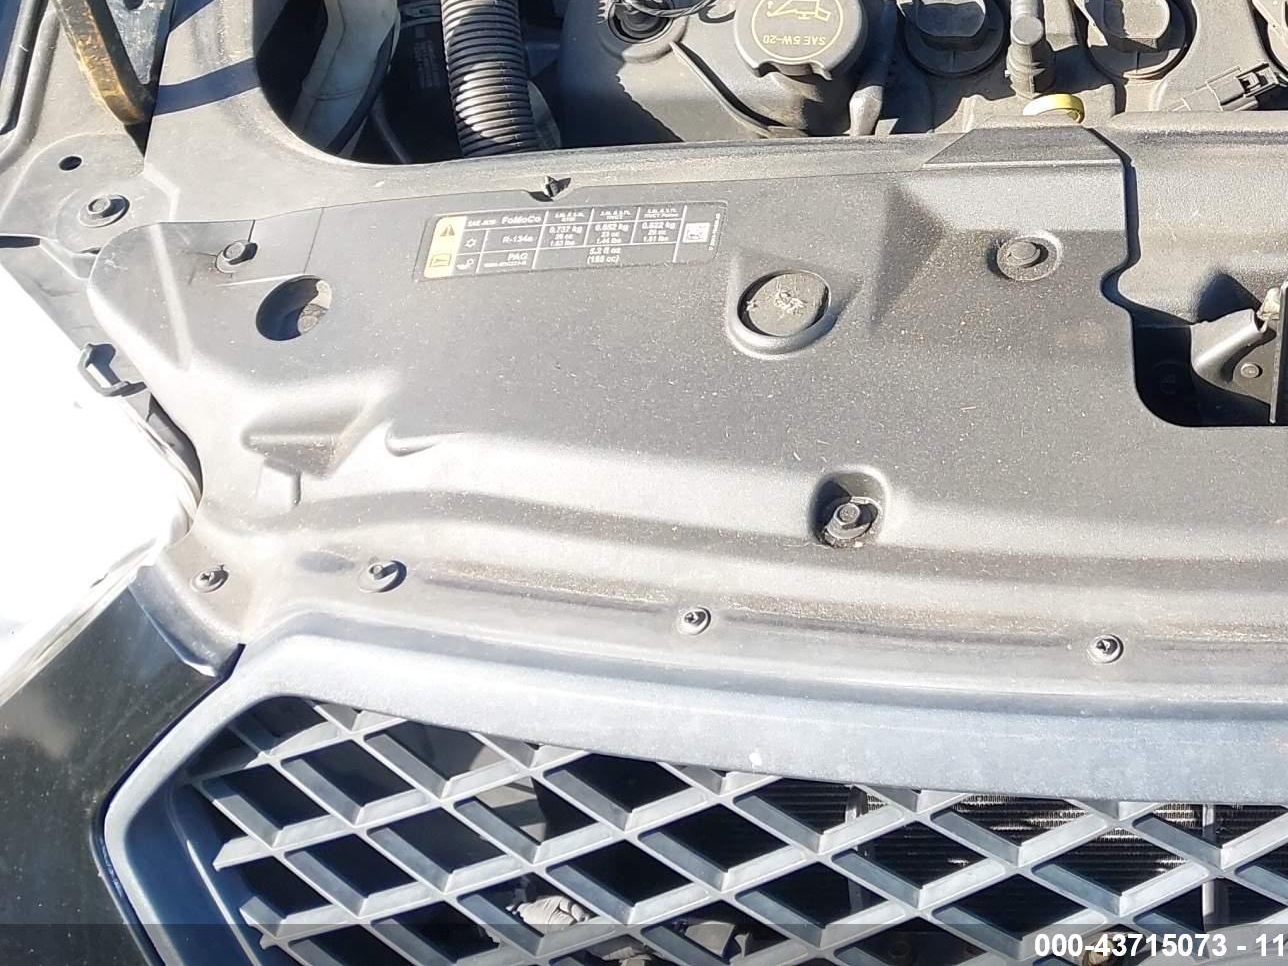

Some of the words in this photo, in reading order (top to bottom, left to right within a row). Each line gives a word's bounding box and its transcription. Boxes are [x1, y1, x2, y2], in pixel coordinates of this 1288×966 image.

[763, 34, 801, 45] 5W-20
[803, 35, 826, 45] SAE
[501, 215, 542, 225] FoMoCo
